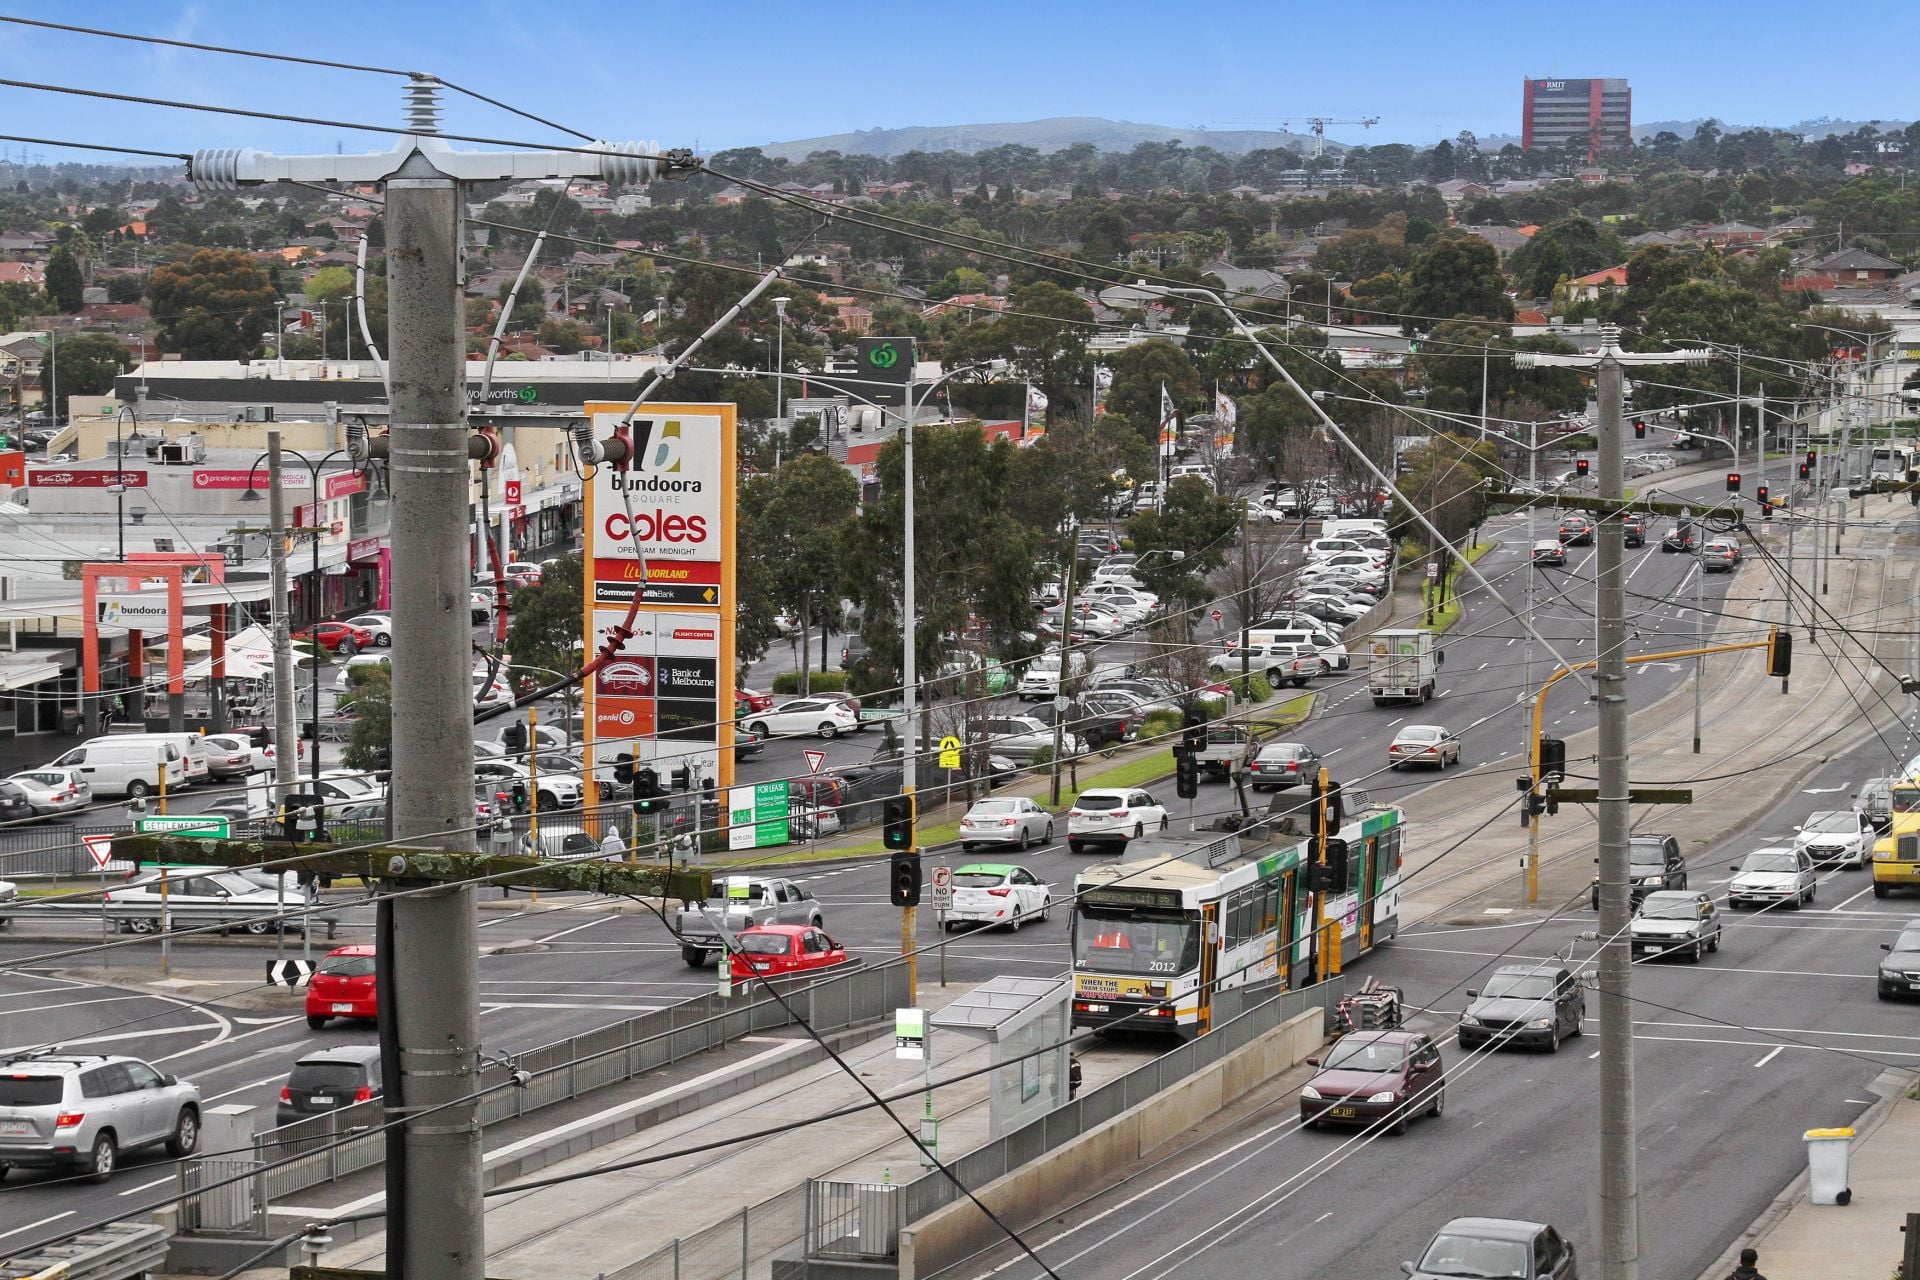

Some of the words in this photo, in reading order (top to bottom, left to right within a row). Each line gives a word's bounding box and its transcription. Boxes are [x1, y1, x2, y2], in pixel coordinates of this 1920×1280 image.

[209, 475, 237, 483] priceline
[632, 494, 680, 504] SQUARE
[605, 508, 707, 543] coles
[659, 548, 697, 556] MIDNIGHT
[121, 605, 167, 615] bundoora
[605, 626, 645, 637] Nao's
[672, 669, 692, 677] Bank
[692, 669, 701, 677] of
[672, 677, 715, 687] Melbourne
[757, 784, 769, 794] FOR
[769, 783, 785, 793] LEASE
[144, 822, 200, 831] SETTLEMENT
[935, 888, 948, 896] NO
[1149, 961, 1176, 972] 2012
[1081, 978, 1103, 987] WHEN
[1105, 979, 1119, 987] THE
